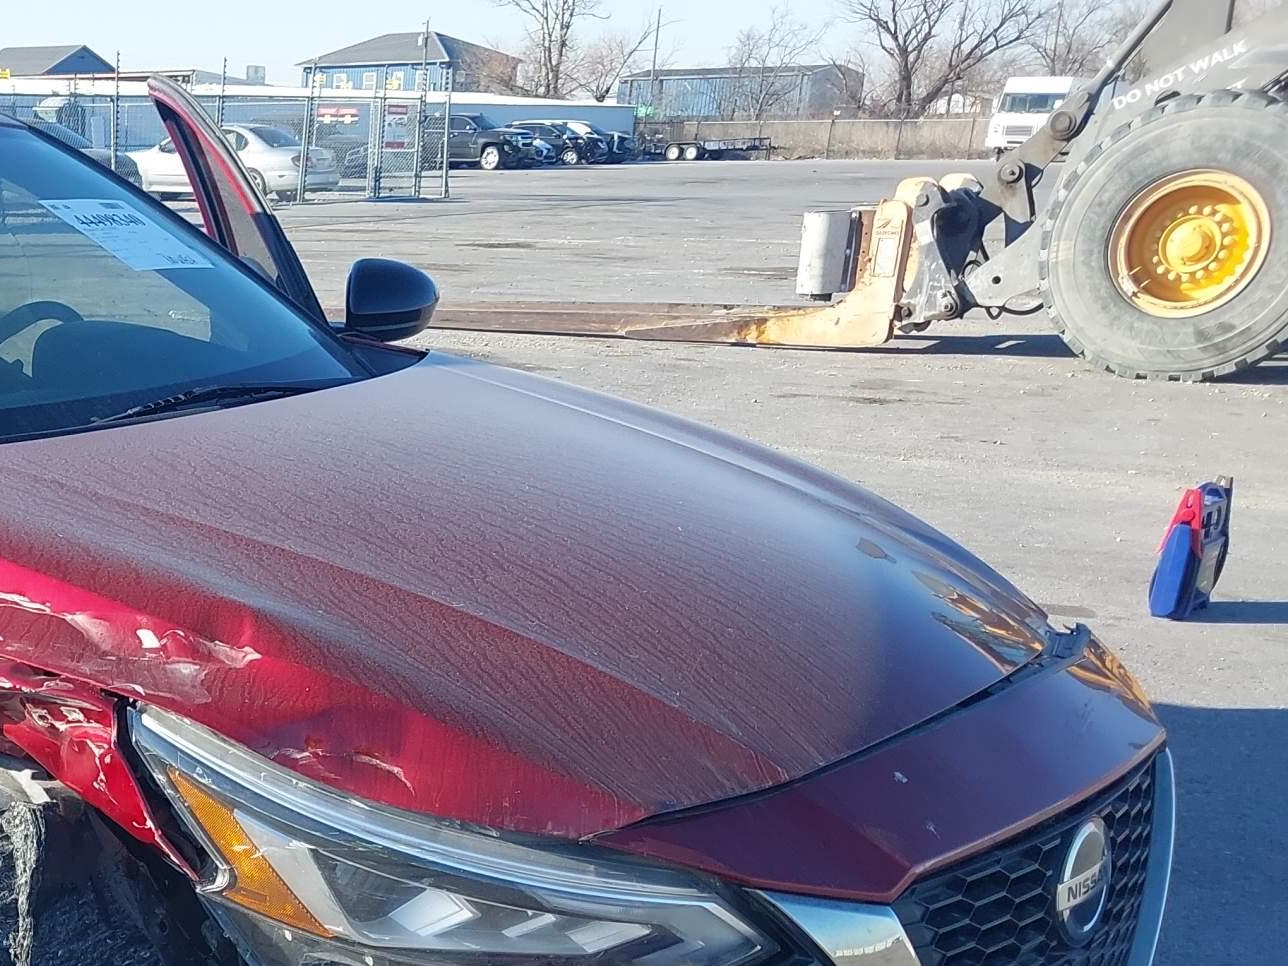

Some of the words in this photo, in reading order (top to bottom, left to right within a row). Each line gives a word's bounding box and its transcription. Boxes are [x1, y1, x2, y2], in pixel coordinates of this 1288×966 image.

[1112, 89, 1142, 110] DO
[1145, 66, 1186, 96] NOT
[1189, 40, 1248, 74] WALK
[1067, 868, 1103, 903] NISS
